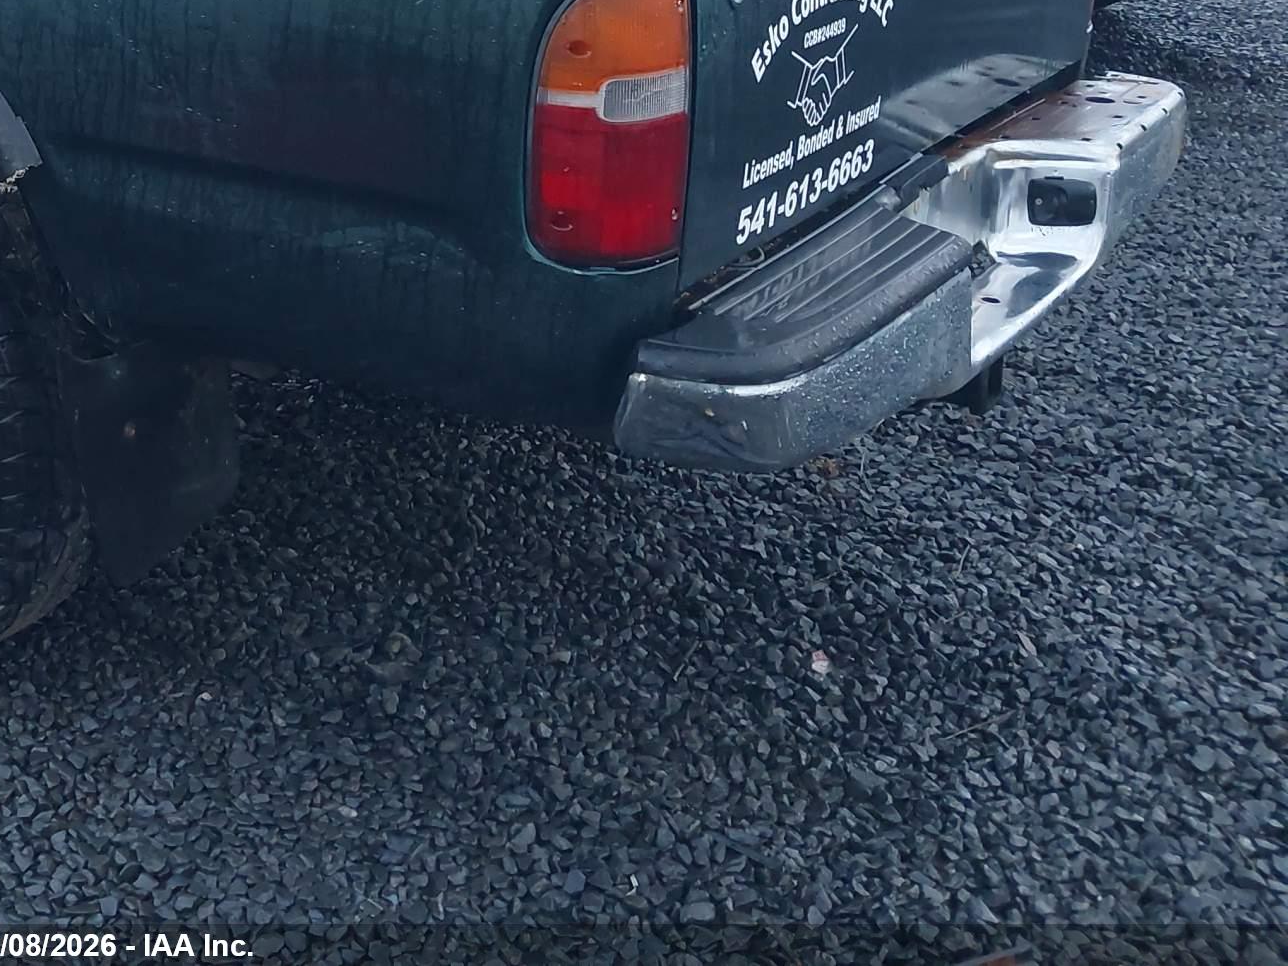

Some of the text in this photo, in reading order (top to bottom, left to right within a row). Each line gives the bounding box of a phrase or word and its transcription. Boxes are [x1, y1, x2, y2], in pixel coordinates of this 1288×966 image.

[751, 15, 789, 83] Esko
[804, 18, 847, 49] CCB#244939
[742, 95, 882, 190] Licensed, Bonded & Insured
[736, 139, 875, 245] 541-613-6663
